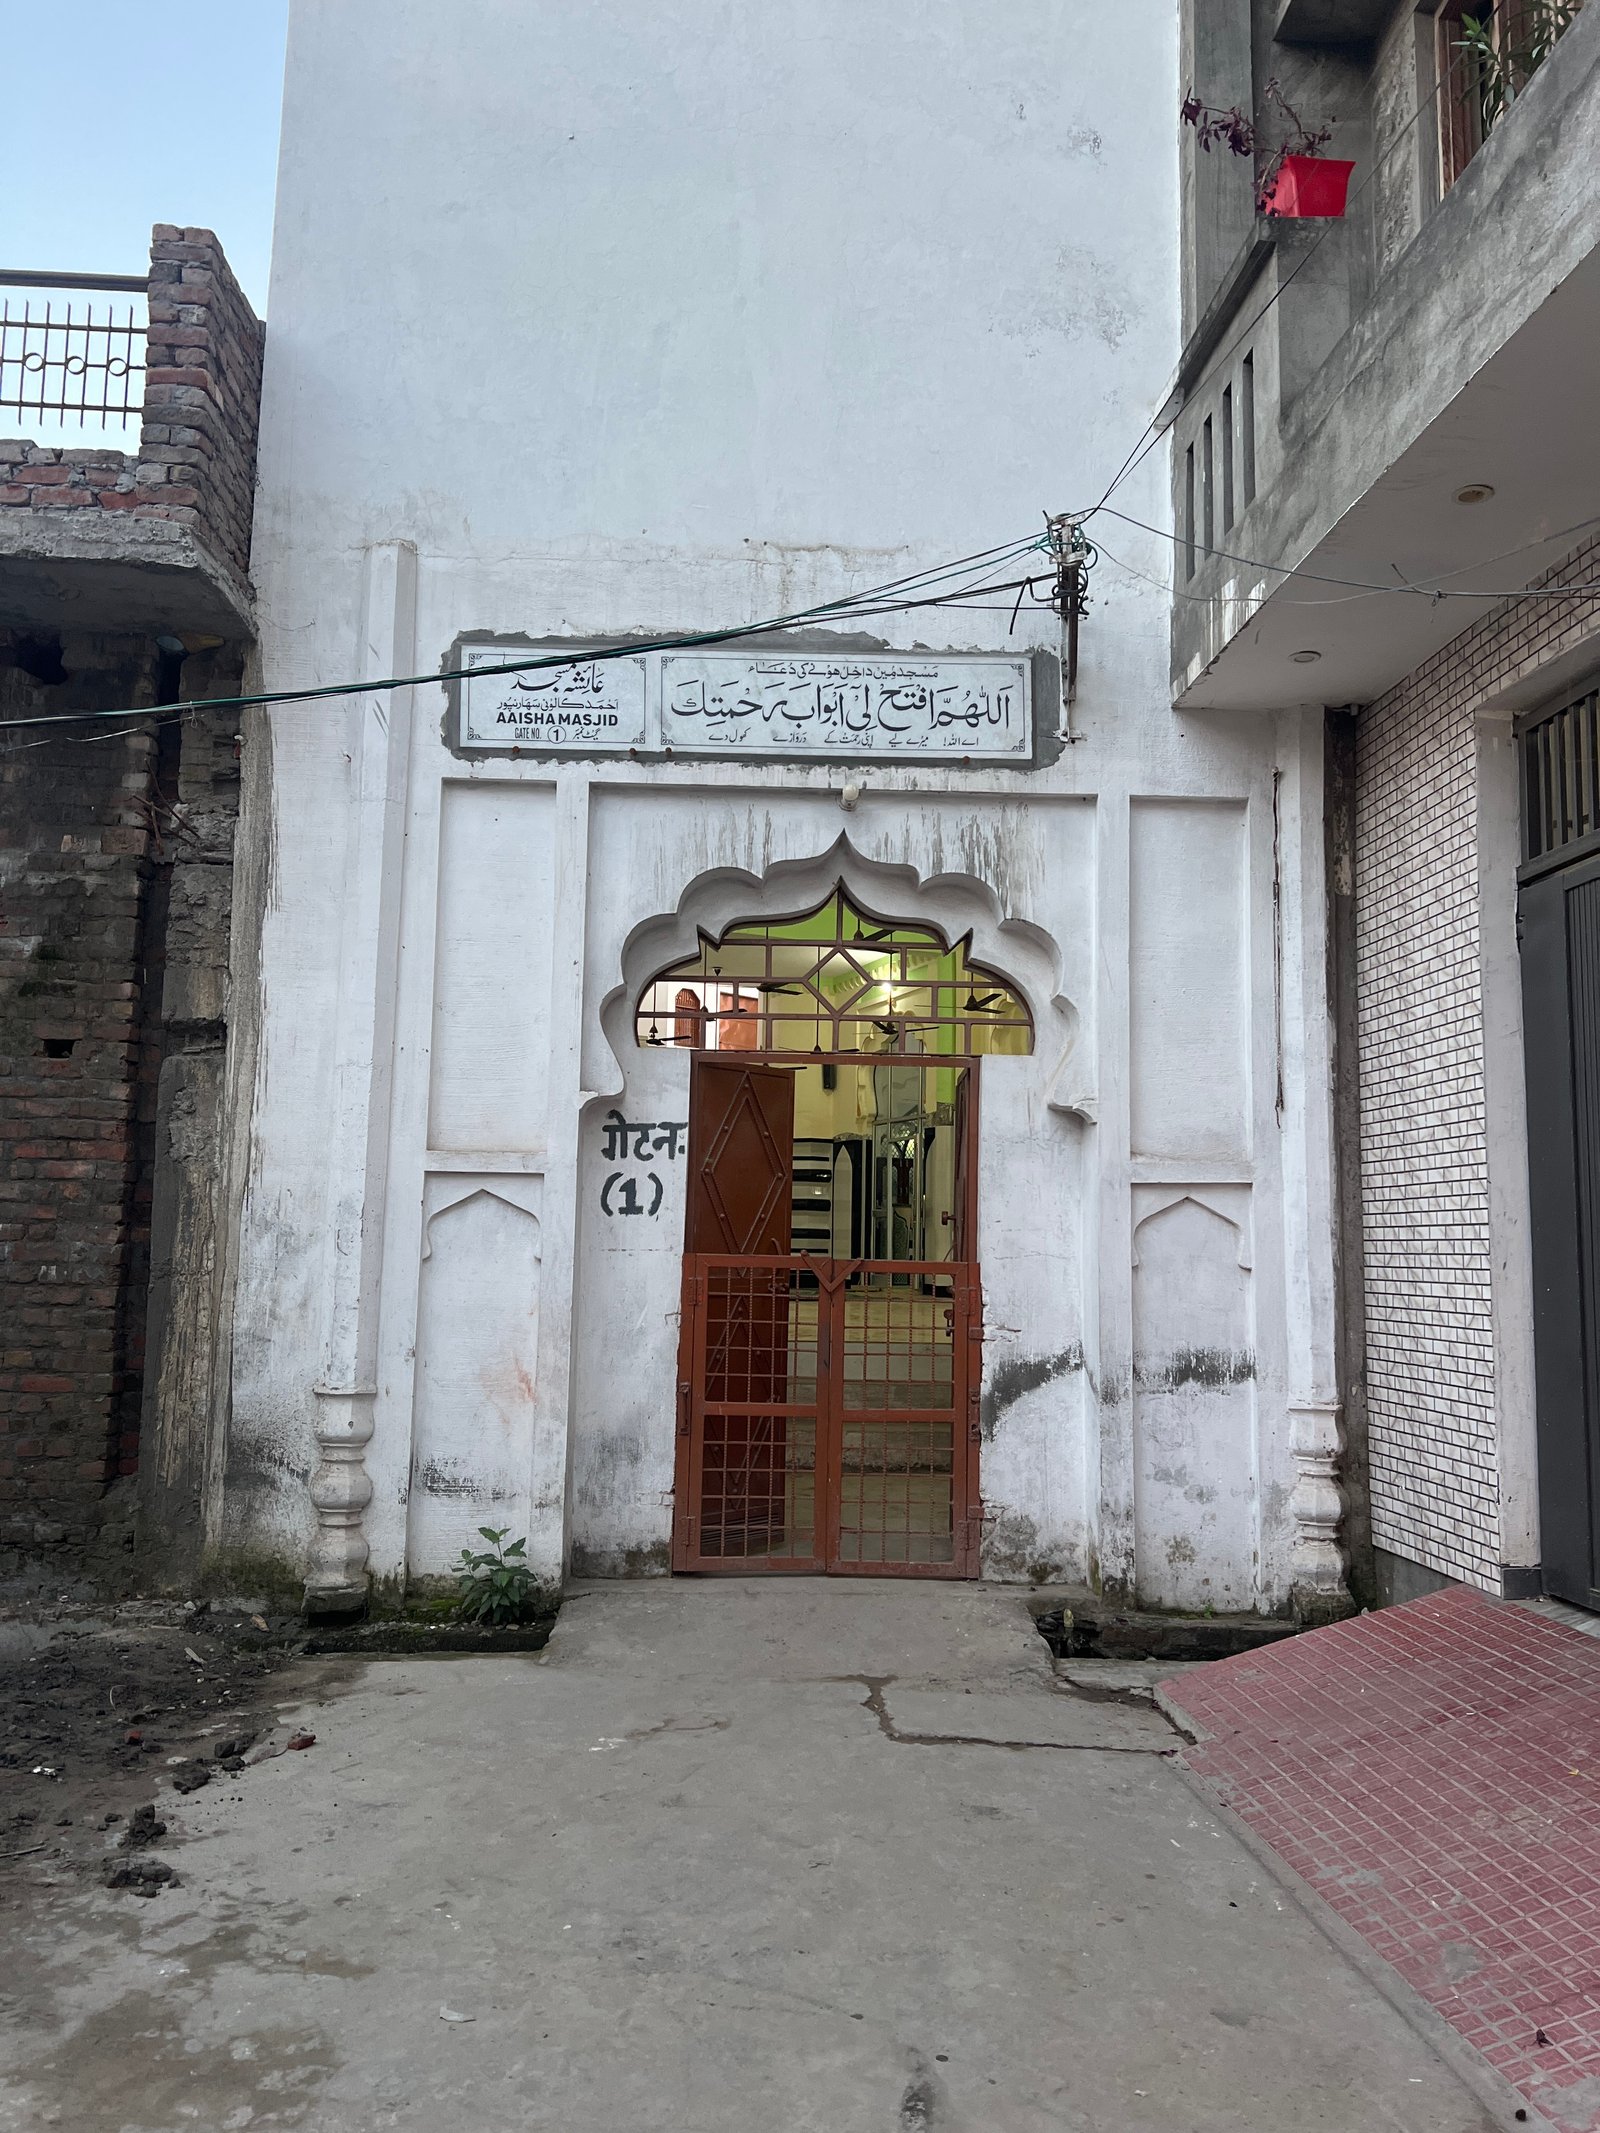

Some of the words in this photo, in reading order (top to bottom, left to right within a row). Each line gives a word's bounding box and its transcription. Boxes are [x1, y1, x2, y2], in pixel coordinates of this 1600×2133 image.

[496, 712, 555, 725] AAISHA
[558, 713, 618, 726] MASJID
[514, 727, 530, 740] GATE
[531, 728, 542, 740] NO.
[600, 1109, 656, 1162] गेट
[600, 1172, 664, 1216] (1)
